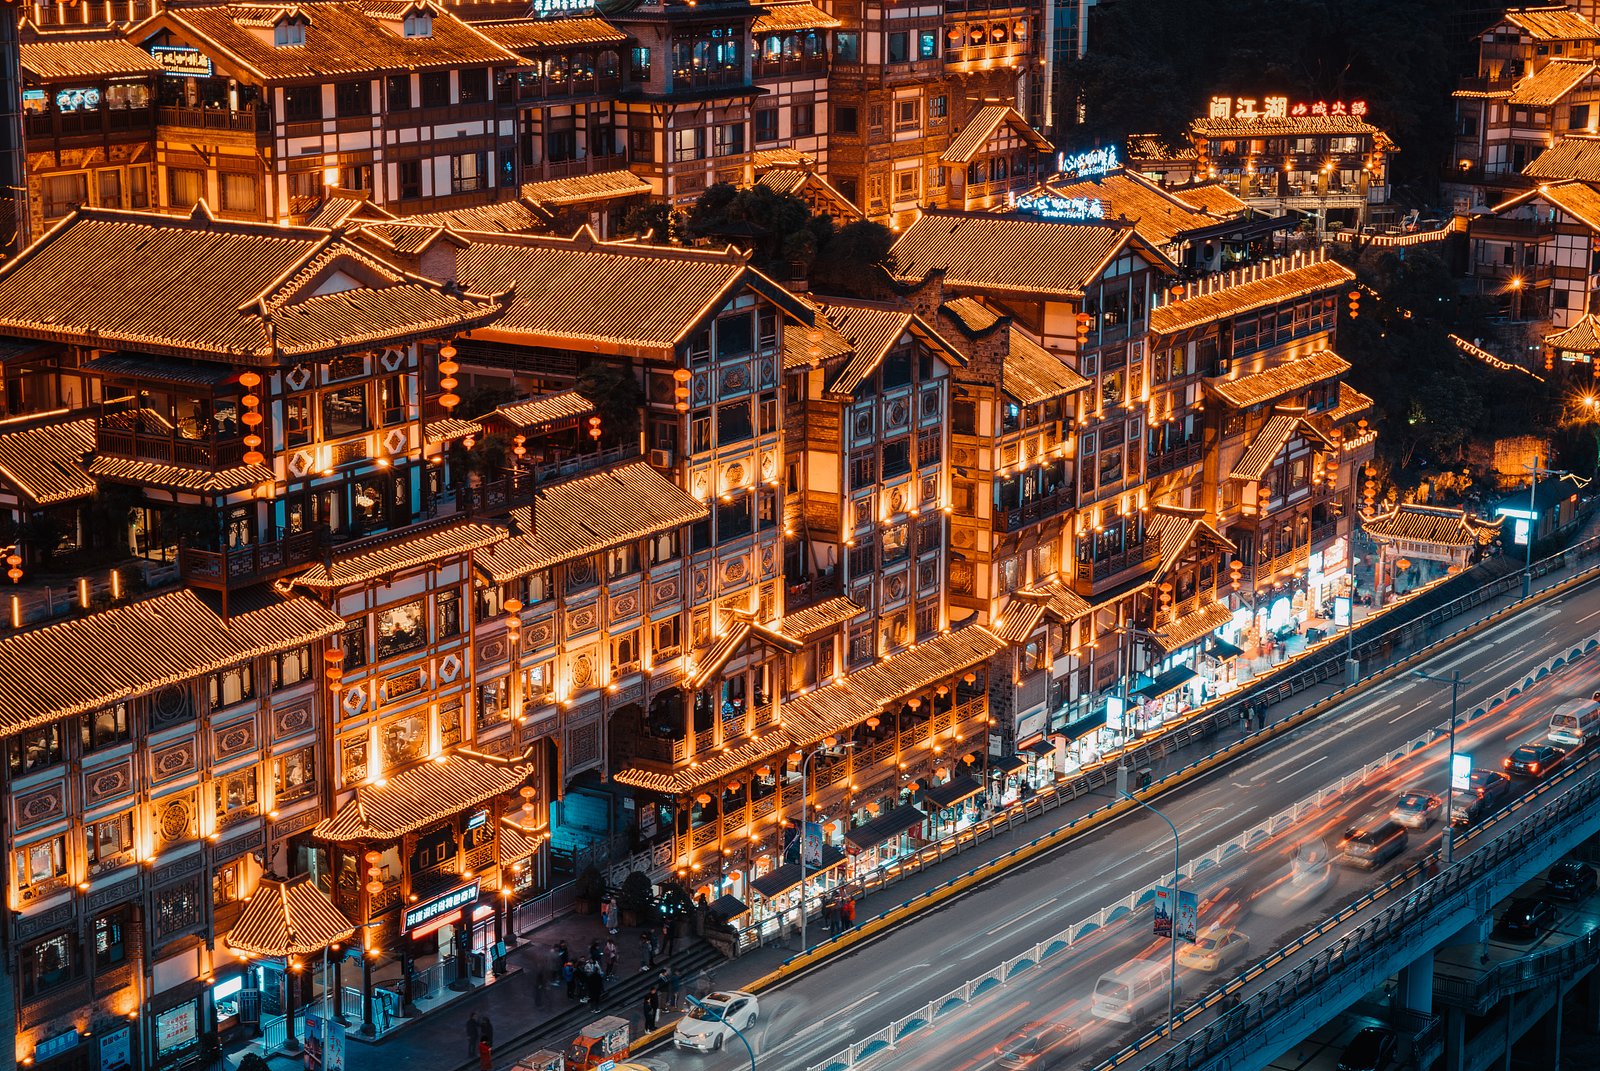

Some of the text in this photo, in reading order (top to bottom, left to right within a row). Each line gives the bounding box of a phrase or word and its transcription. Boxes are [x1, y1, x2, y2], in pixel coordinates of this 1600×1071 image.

[1209, 96, 1367, 119] 闹江湖 山城火锅
